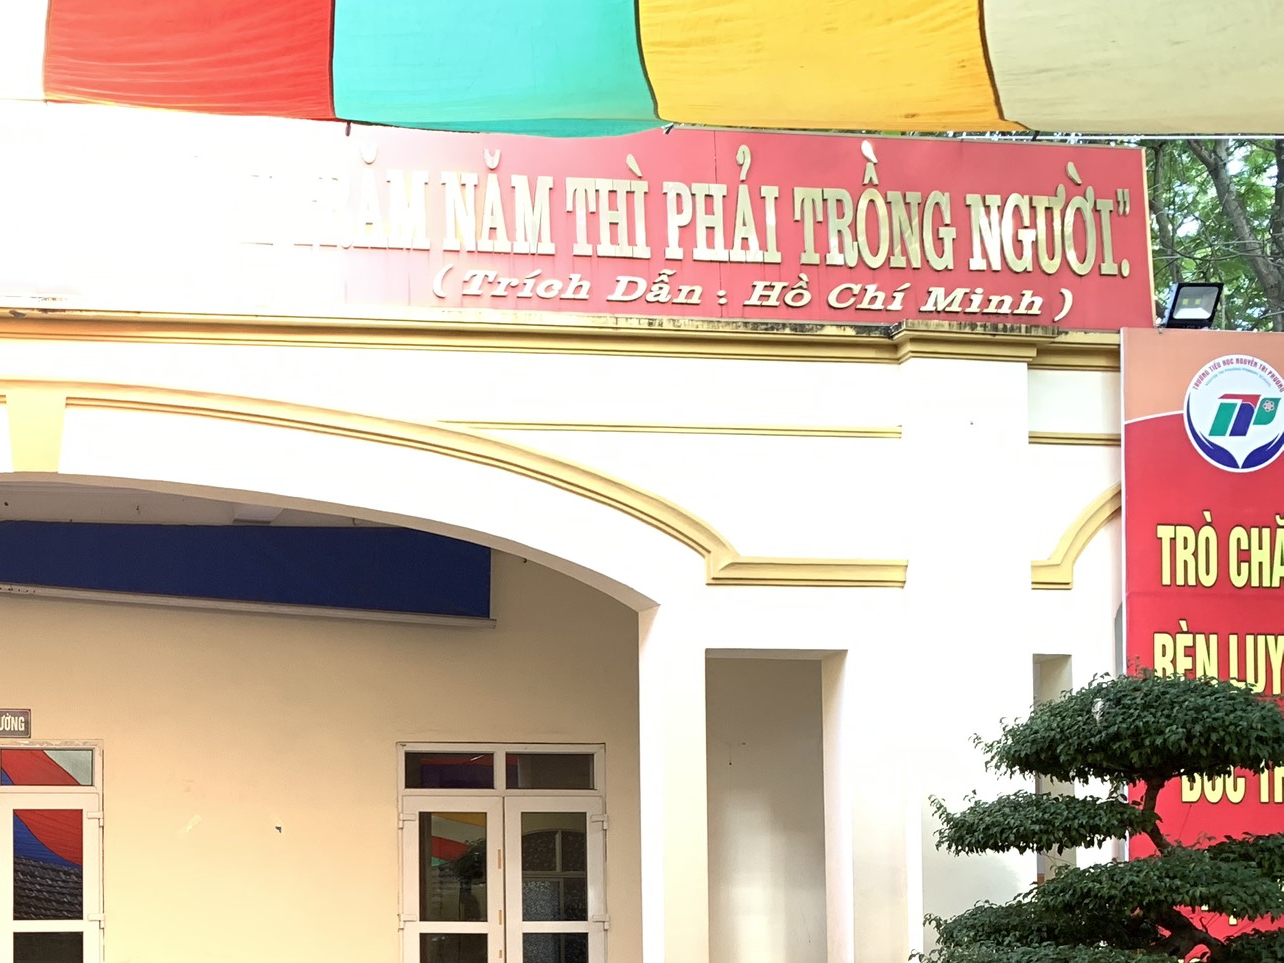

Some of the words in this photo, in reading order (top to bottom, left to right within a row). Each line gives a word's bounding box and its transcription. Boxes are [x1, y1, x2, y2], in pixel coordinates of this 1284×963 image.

[441, 148, 555, 255] NĂM
[565, 153, 651, 259] THÌ
[662, 145, 782, 263] PHẢI
[793, 139, 956, 271] TRỒNG
[607, 268, 702, 304] Dẫn
[744, 273, 812, 308] Hồ
[828, 282, 912, 312] Chí
[920, 286, 1042, 315] Minh
[1156, 510, 1218, 587] TRÒ
